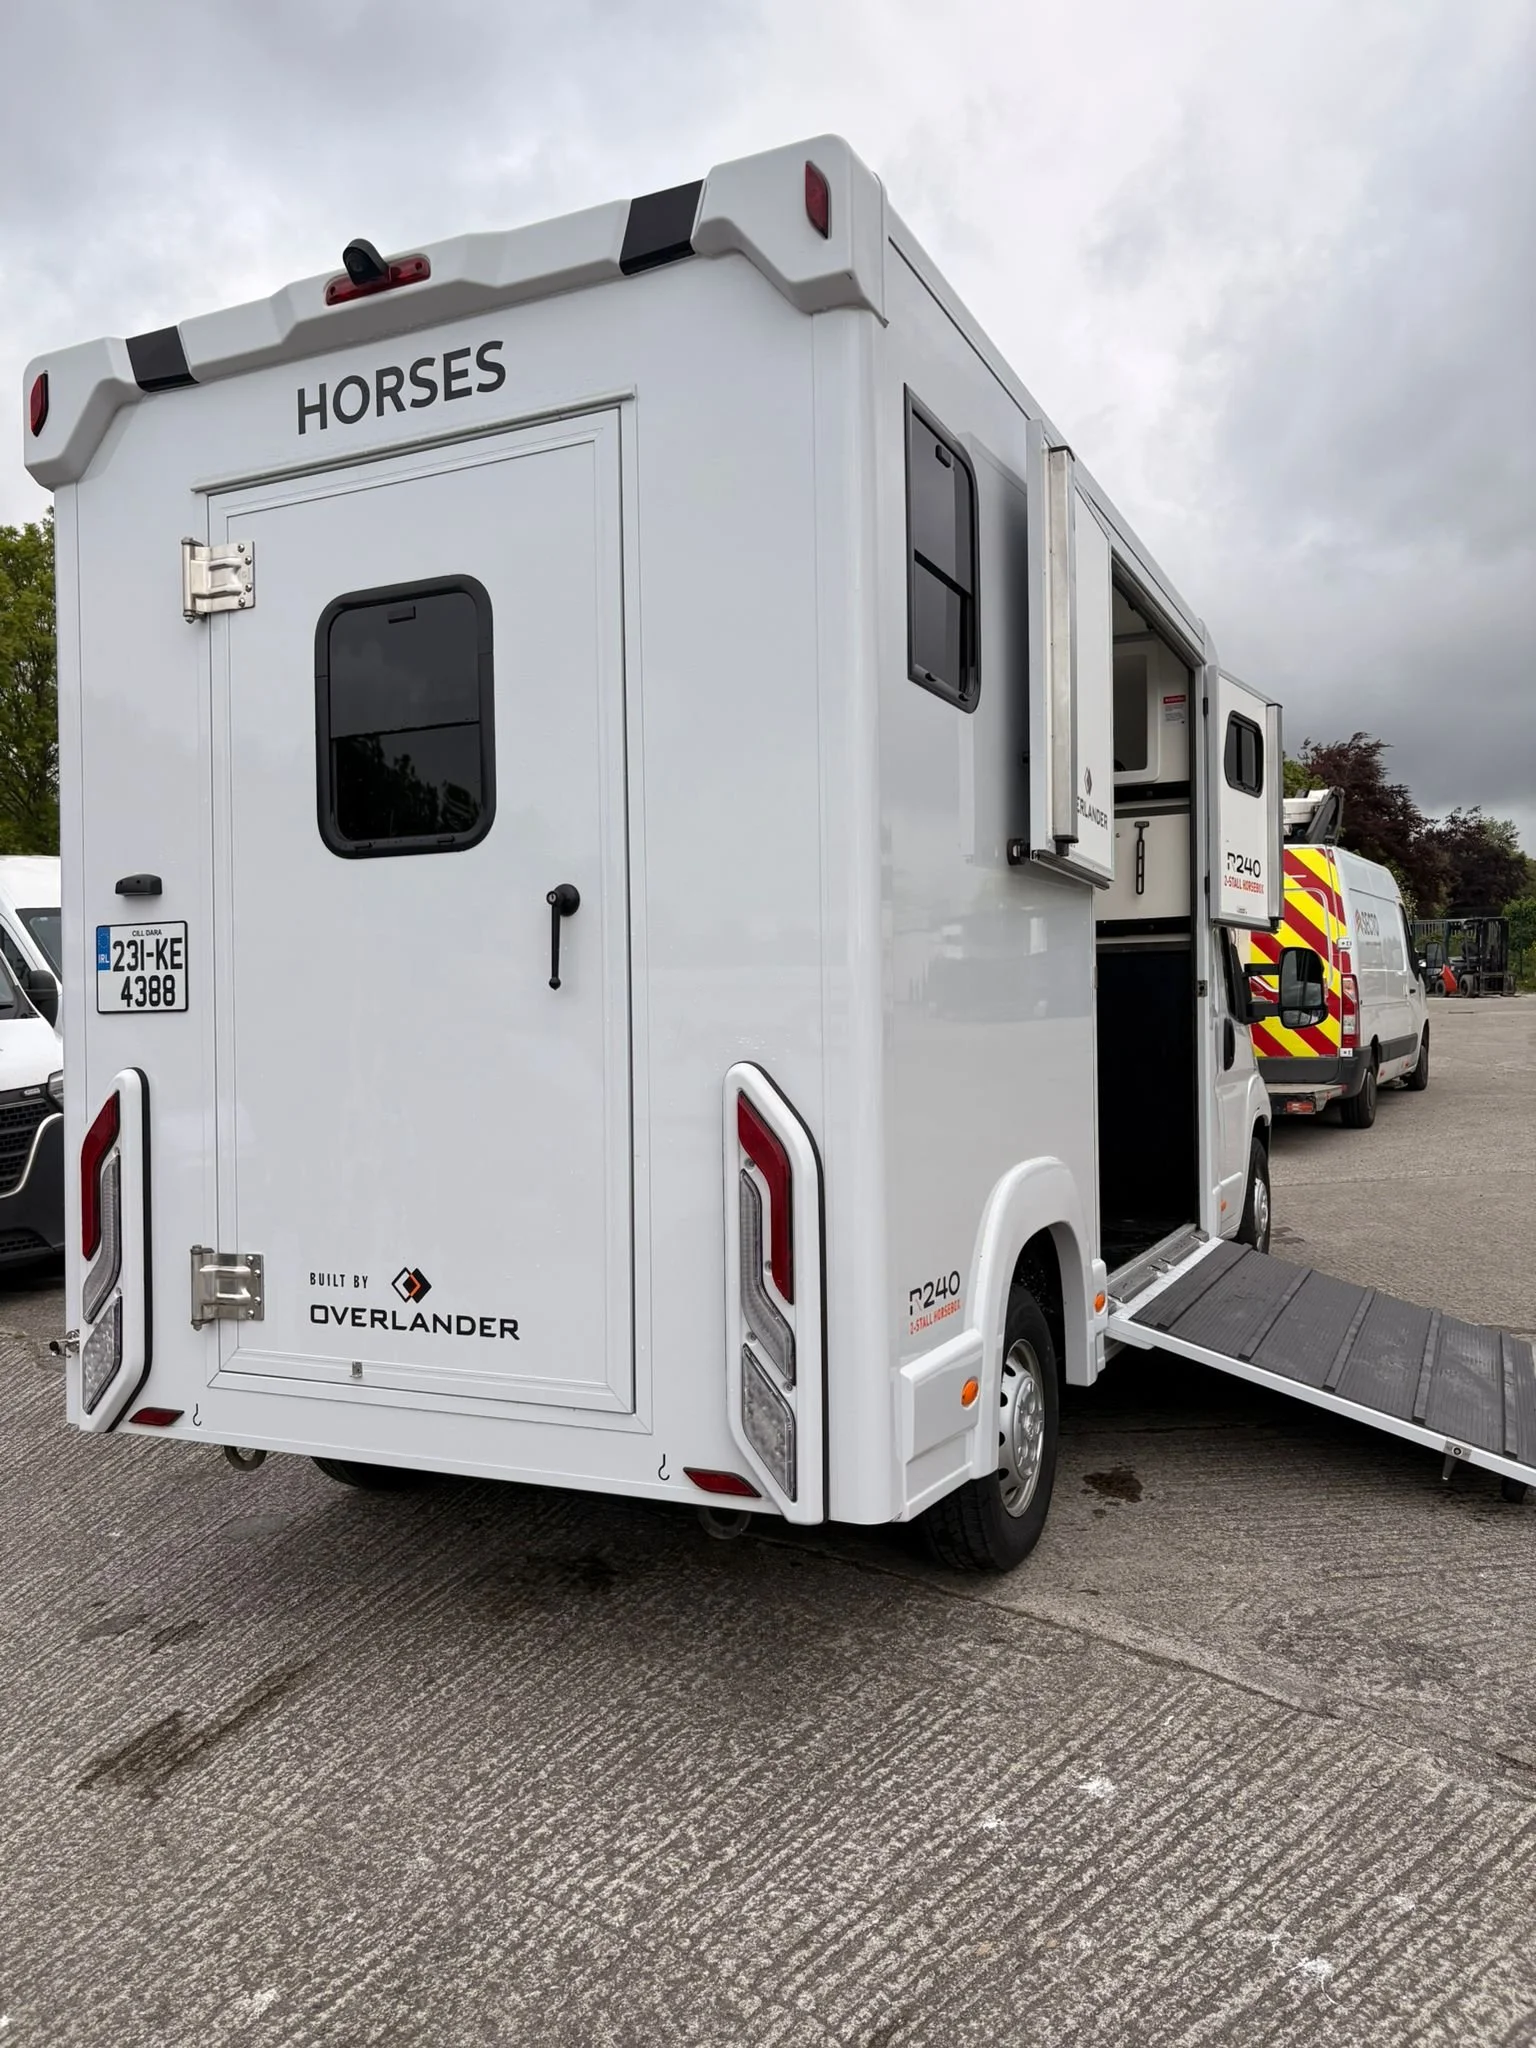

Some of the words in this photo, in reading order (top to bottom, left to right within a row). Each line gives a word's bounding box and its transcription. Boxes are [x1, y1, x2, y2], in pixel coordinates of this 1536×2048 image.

[297, 340, 506, 435] HORSES
[1077, 796, 1108, 830] ERLANDER
[1227, 852, 1261, 878] R240
[132, 929, 145, 937] CILL
[146, 928, 162, 936] DARA
[98, 953, 110, 964] IRL
[112, 937, 183, 972] 231-KE
[120, 974, 175, 1008] 4388
[310, 1272, 346, 1288] BUILT
[353, 1275, 369, 1289] BY
[909, 1270, 960, 1316] R240
[310, 1304, 520, 1340] OVERLANDER
